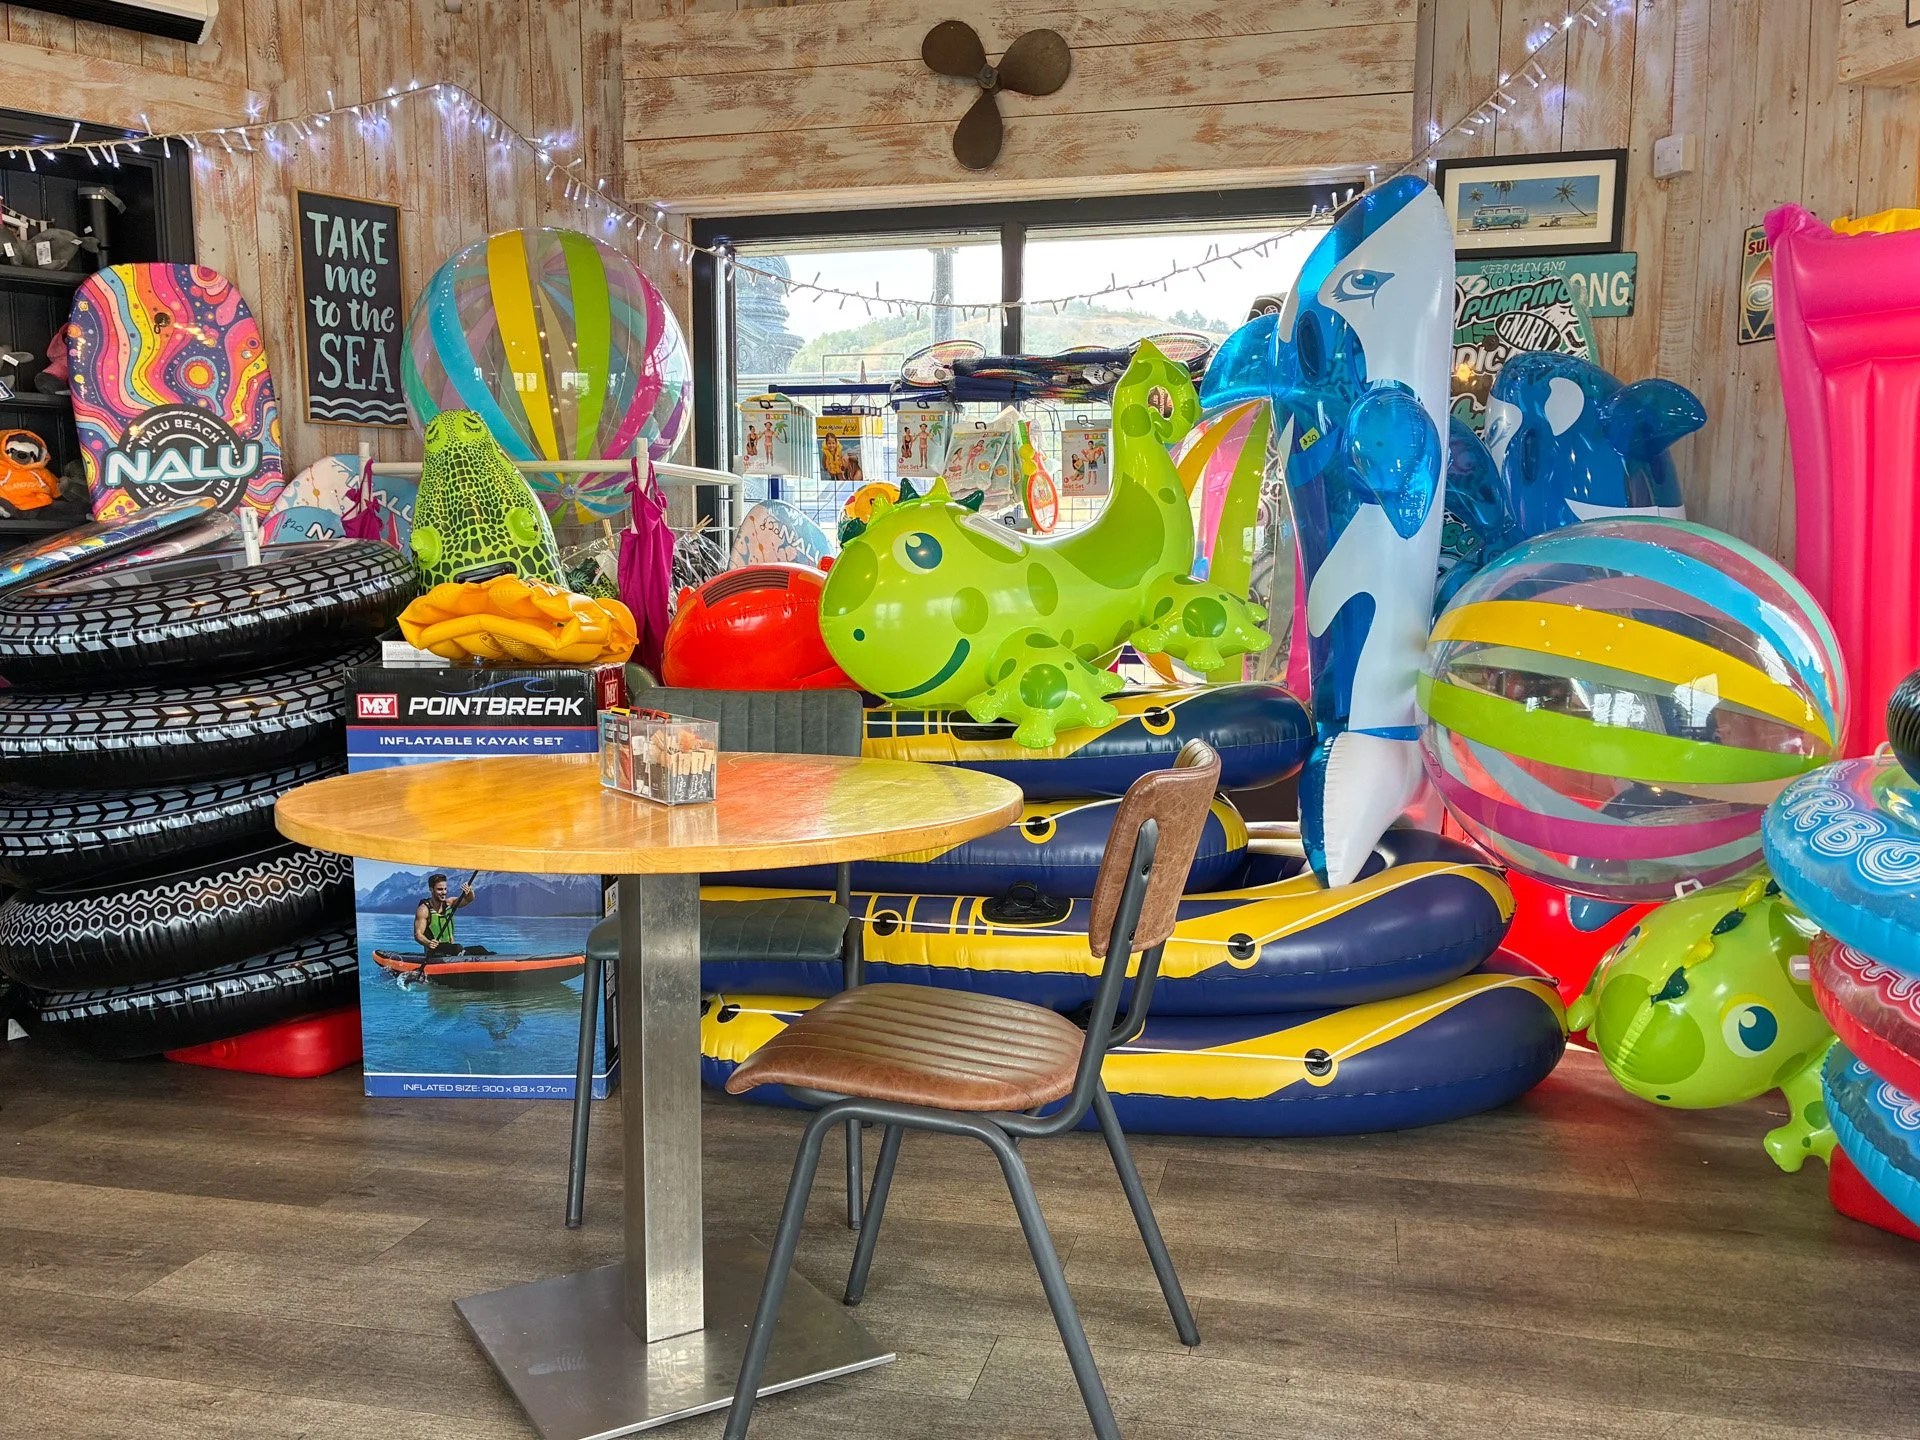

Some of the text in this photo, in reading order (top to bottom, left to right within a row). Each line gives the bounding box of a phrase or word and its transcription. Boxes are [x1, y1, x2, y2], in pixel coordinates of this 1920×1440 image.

[306, 211, 389, 265] TAKE
[324, 263, 377, 297] me
[1480, 261, 1567, 275] KEEP CALM AND
[309, 295, 395, 333] to the
[1499, 313, 1559, 352] GNARLY
[317, 333, 395, 394] SEA
[138, 418, 220, 448] NALU BEACH
[106, 444, 259, 486] NALU
[408, 696, 585, 716] POINTBREAK
[379, 736, 564, 746] INFLATABLE KAYAK SET
[403, 1083, 454, 1092] INFLATED
[454, 1084, 481, 1092] SIZE:
[482, 1085, 504, 1093] 300
[513, 1085, 529, 1093] 93
[537, 1085, 568, 1093] 37cm
